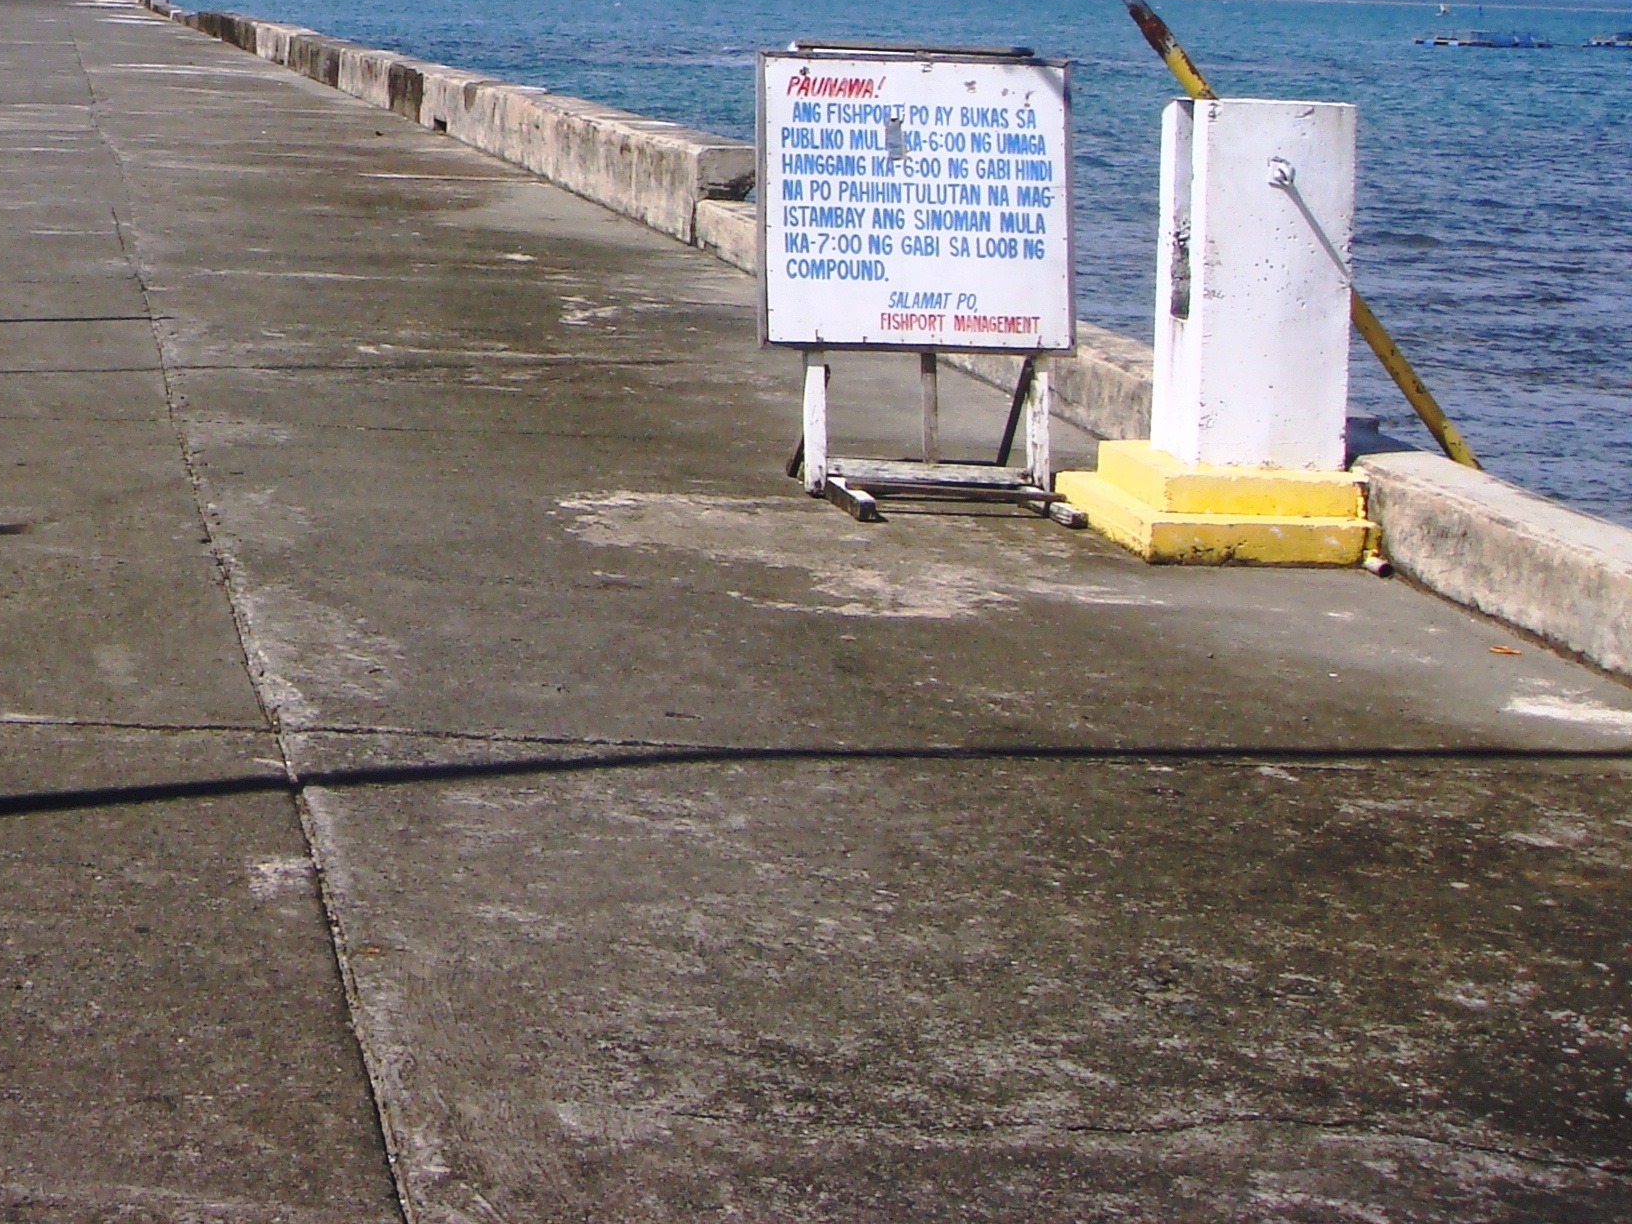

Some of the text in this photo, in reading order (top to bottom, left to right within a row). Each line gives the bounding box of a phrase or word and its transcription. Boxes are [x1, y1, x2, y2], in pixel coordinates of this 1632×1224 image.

[787, 75, 887, 98] PAUNAWA!
[792, 101, 1036, 129] ANG FISHPORT PO AY BUKAS SA
[781, 127, 1046, 156] PUBLIKO MUL KA-6:00 NG UMAGA
[781, 153, 1052, 182] HANGGANG IKA-6:00 NG GABI HINDI
[782, 179, 1055, 208] NA PO PAHIHINTULUTAN NA MAG-
[783, 205, 1046, 234] ISTAMBAY ANG SINOMAN MULA
[784, 232, 1045, 260] IKA-7:00 NG GABI SA LOOB NG
[786, 258, 889, 282] COMPOUND.
[888, 291, 979, 313] SALAMAT PO,
[880, 312, 1041, 334] FISHPORT MANAGEMENT
